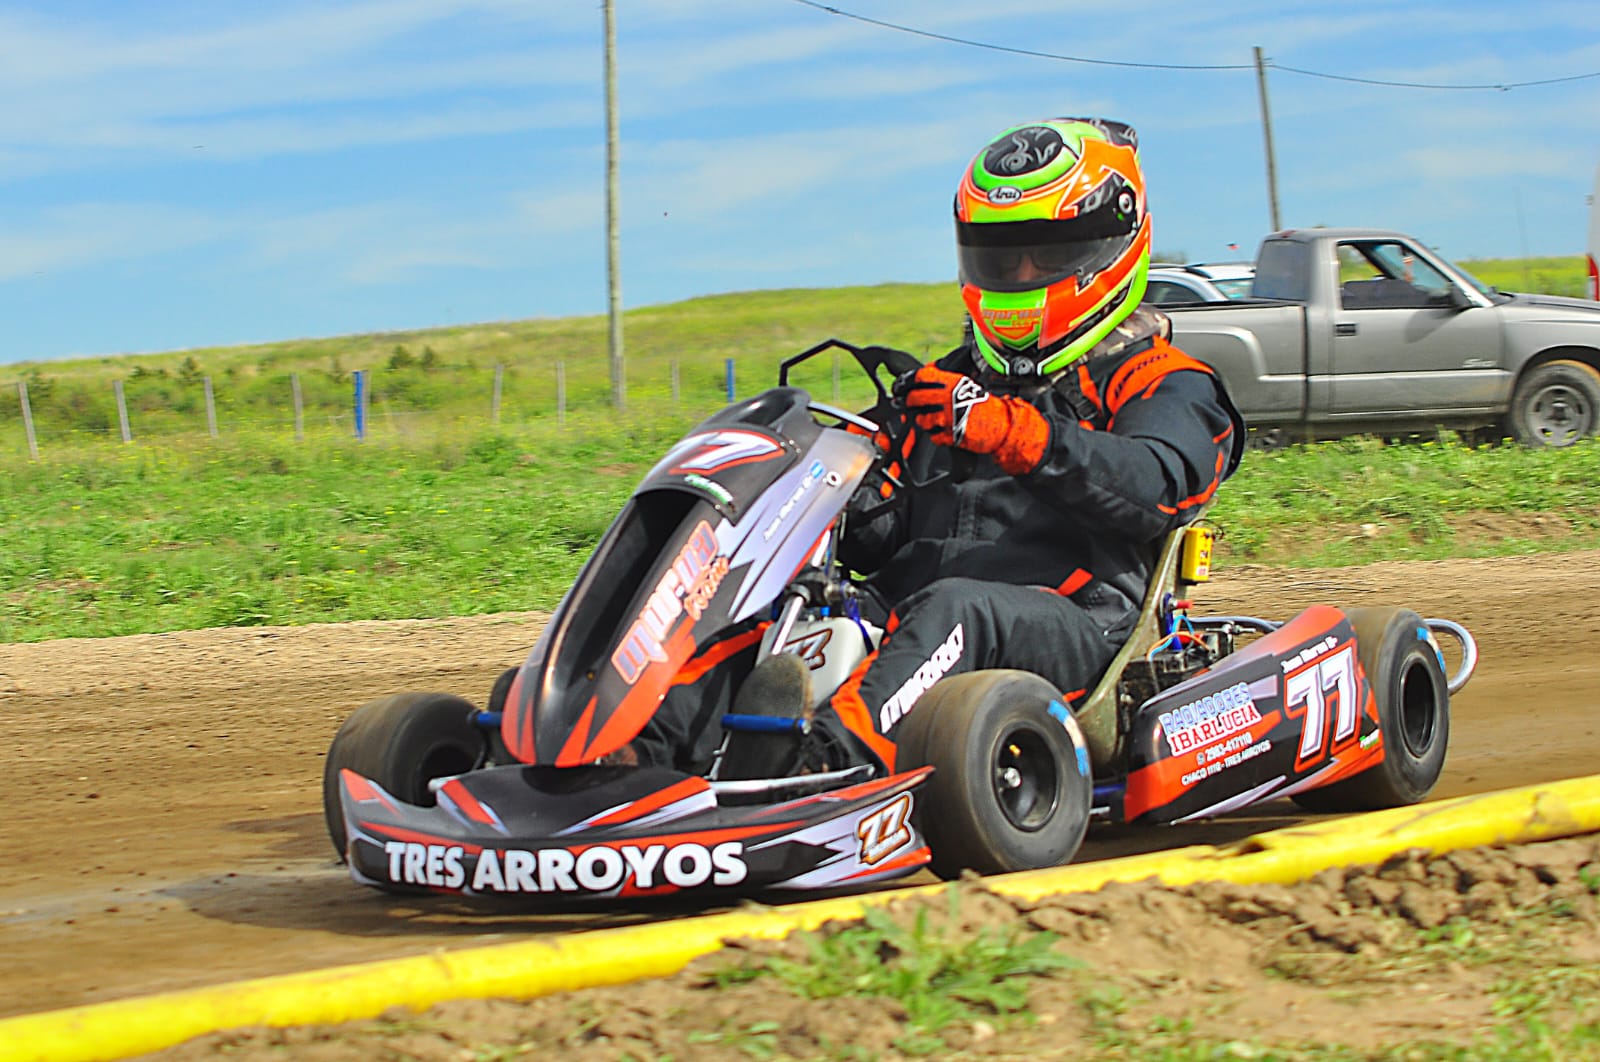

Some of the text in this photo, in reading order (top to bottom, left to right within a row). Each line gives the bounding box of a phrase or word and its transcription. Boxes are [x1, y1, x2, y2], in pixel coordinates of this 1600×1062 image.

[1160, 683, 1251, 734] RADIADORES
[1286, 646, 1357, 759] 77
[1170, 704, 1260, 752] IBARLUCIA
[385, 842, 748, 892] TRES ARROYOS
